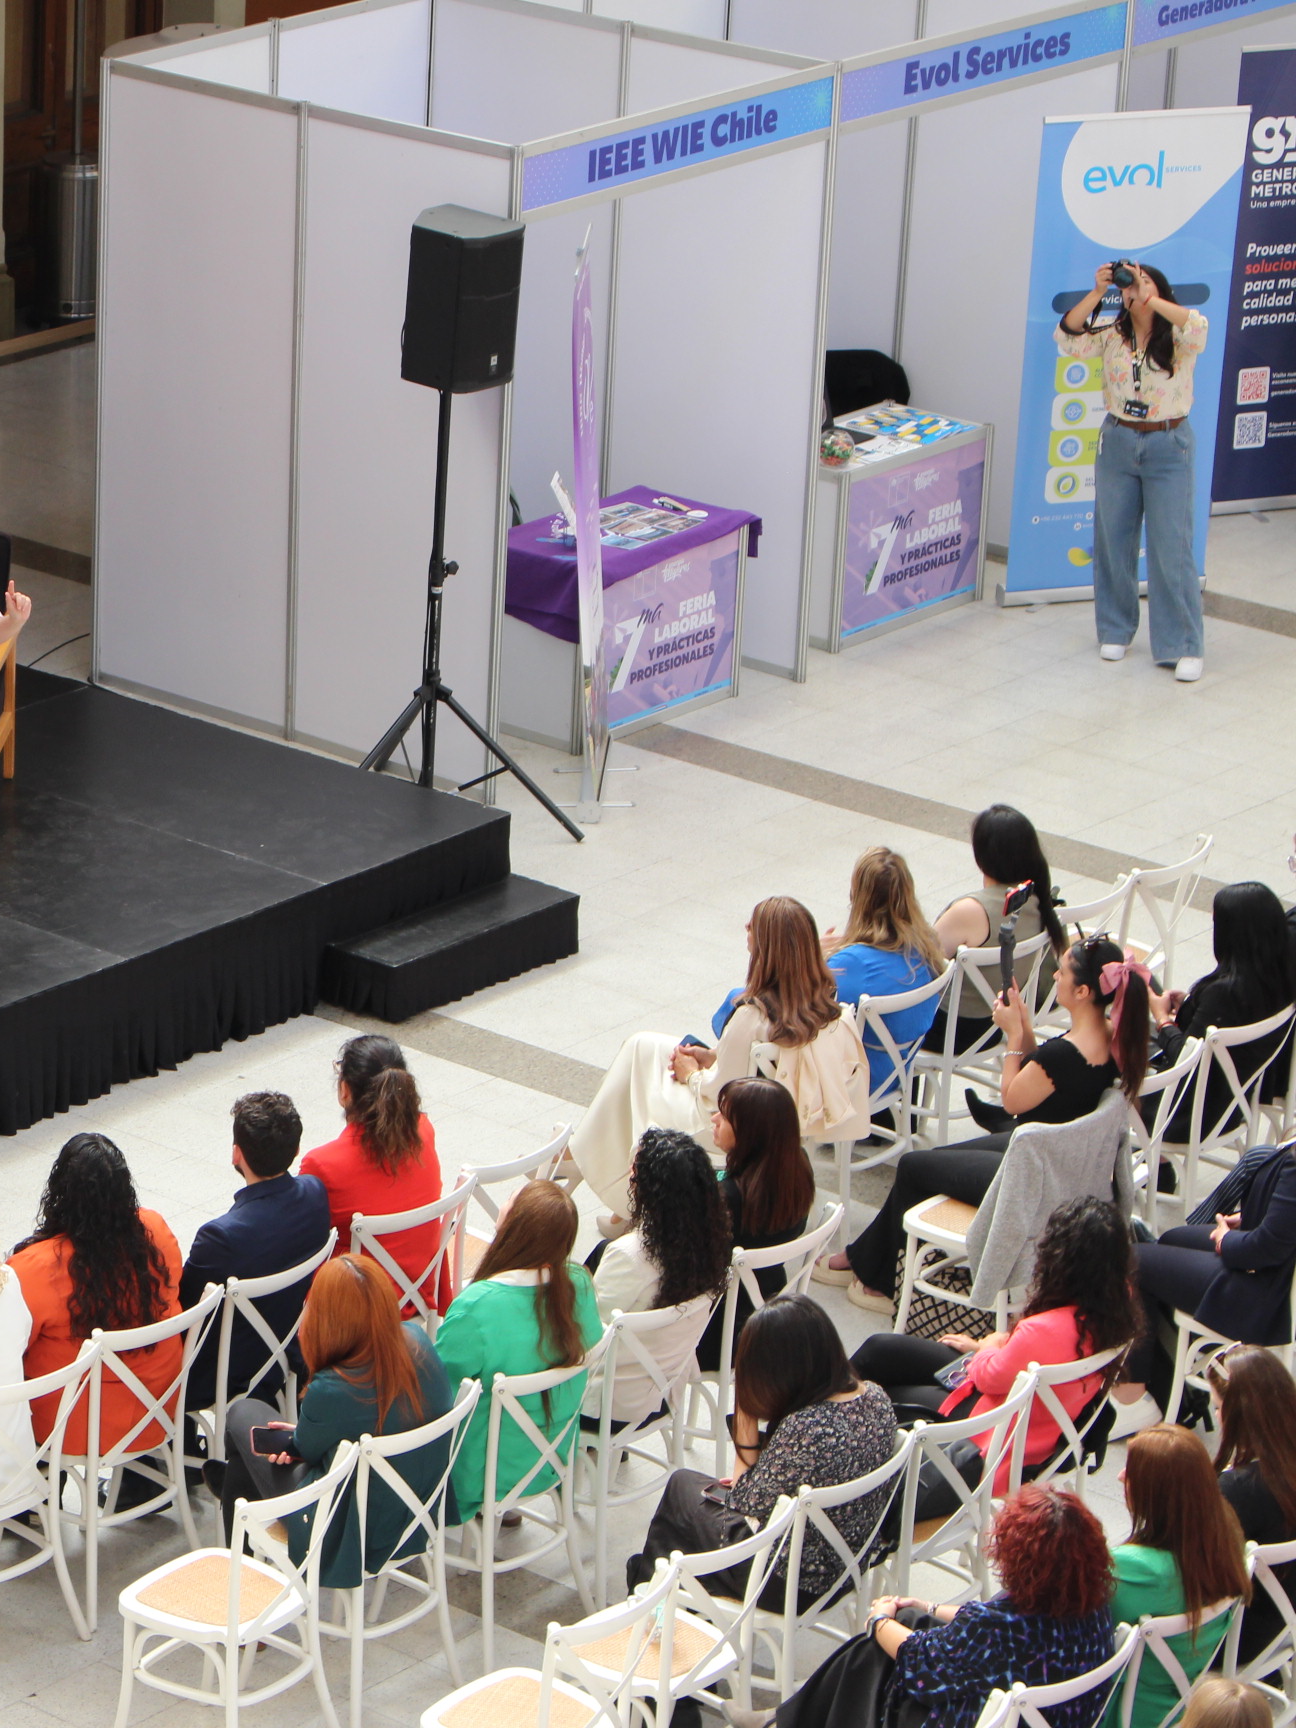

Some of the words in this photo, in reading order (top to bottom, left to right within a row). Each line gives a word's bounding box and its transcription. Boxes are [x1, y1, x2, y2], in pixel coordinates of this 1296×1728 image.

[904, 51, 960, 95] Evol
[964, 32, 1070, 79] Services
[588, 137, 645, 183] IEEE
[650, 119, 705, 164] WIE
[710, 104, 778, 148] Chile
[1083, 150, 1165, 194] evol
[1165, 165, 1202, 173] SERVICES
[1250, 200, 1268, 208] Una
[1242, 291, 1294, 310] calidad
[1243, 279, 1275, 296] para
[928, 499, 962, 525] FERIA
[900, 550, 907, 566] Y
[907, 533, 962, 563] PRÁCTICAS
[905, 516, 962, 549] LABORAL
[883, 549, 961, 588] PROFESIONALES
[679, 590, 716, 617] FERIA
[654, 608, 716, 644] LABORAL
[648, 648, 657, 662] Y
[656, 626, 716, 659] PRÁCTICAS
[629, 642, 715, 685] PROFESIONALES
